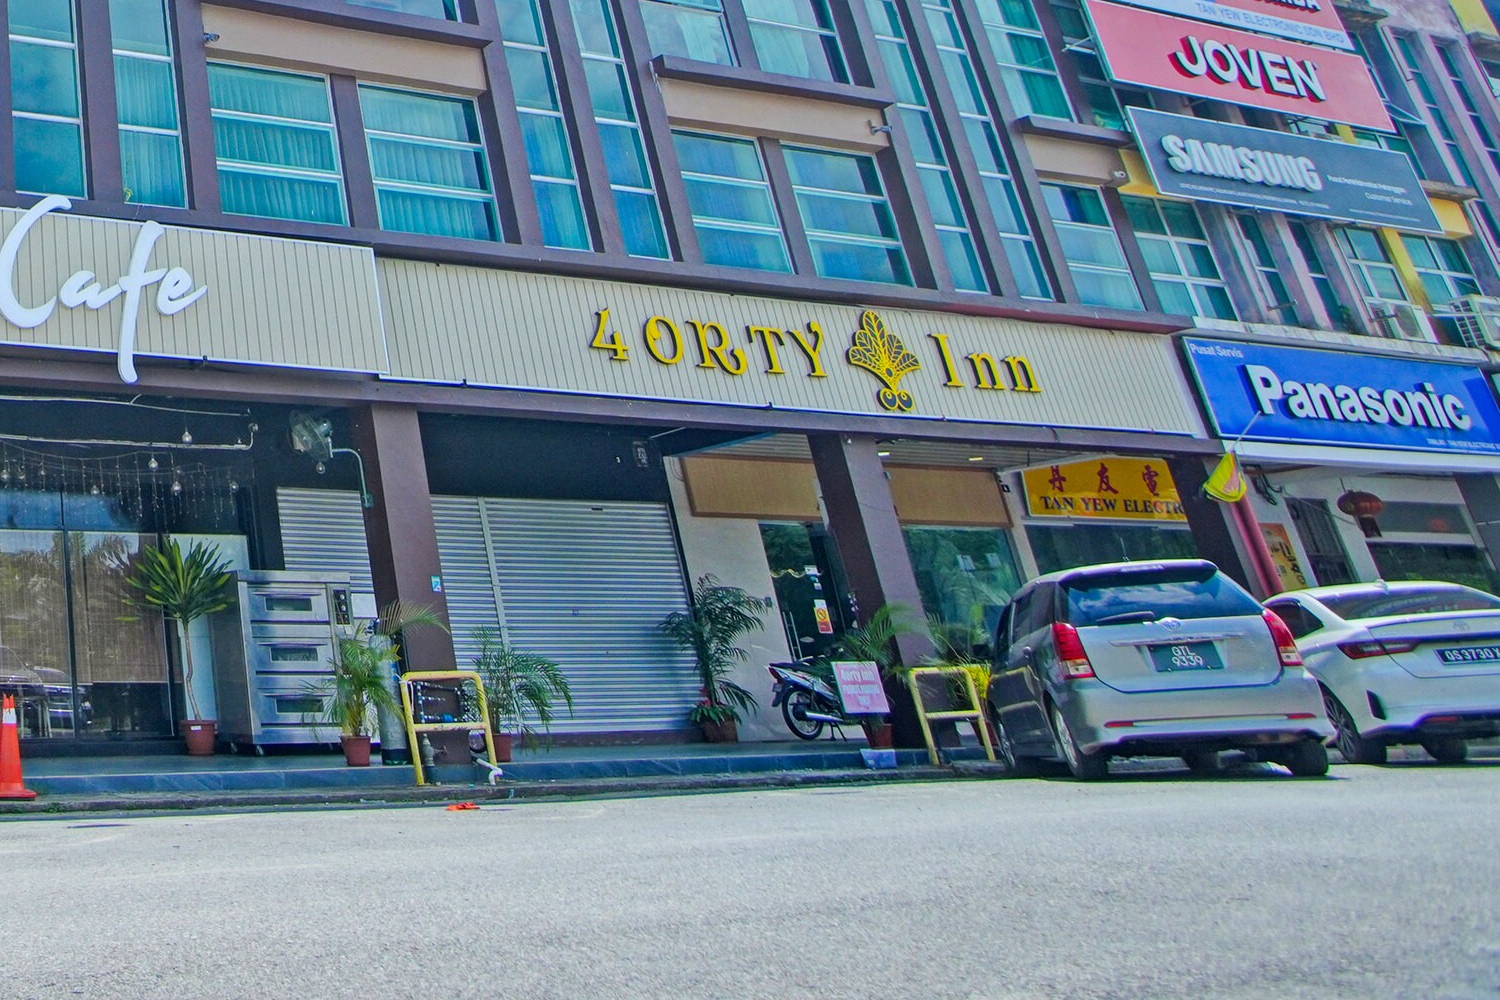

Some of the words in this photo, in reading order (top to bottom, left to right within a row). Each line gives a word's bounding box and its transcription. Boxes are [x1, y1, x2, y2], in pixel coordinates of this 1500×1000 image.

[1173, 35, 1327, 102] JOVEN
[1160, 134, 1323, 193] SAMSUNG
[928, 333, 1042, 393] Inn
[1244, 364, 1472, 431] Panasonic
[1040, 495, 1075, 510] TAN
[1081, 497, 1117, 512] YEW
[1171, 655, 1204, 667] 9339
